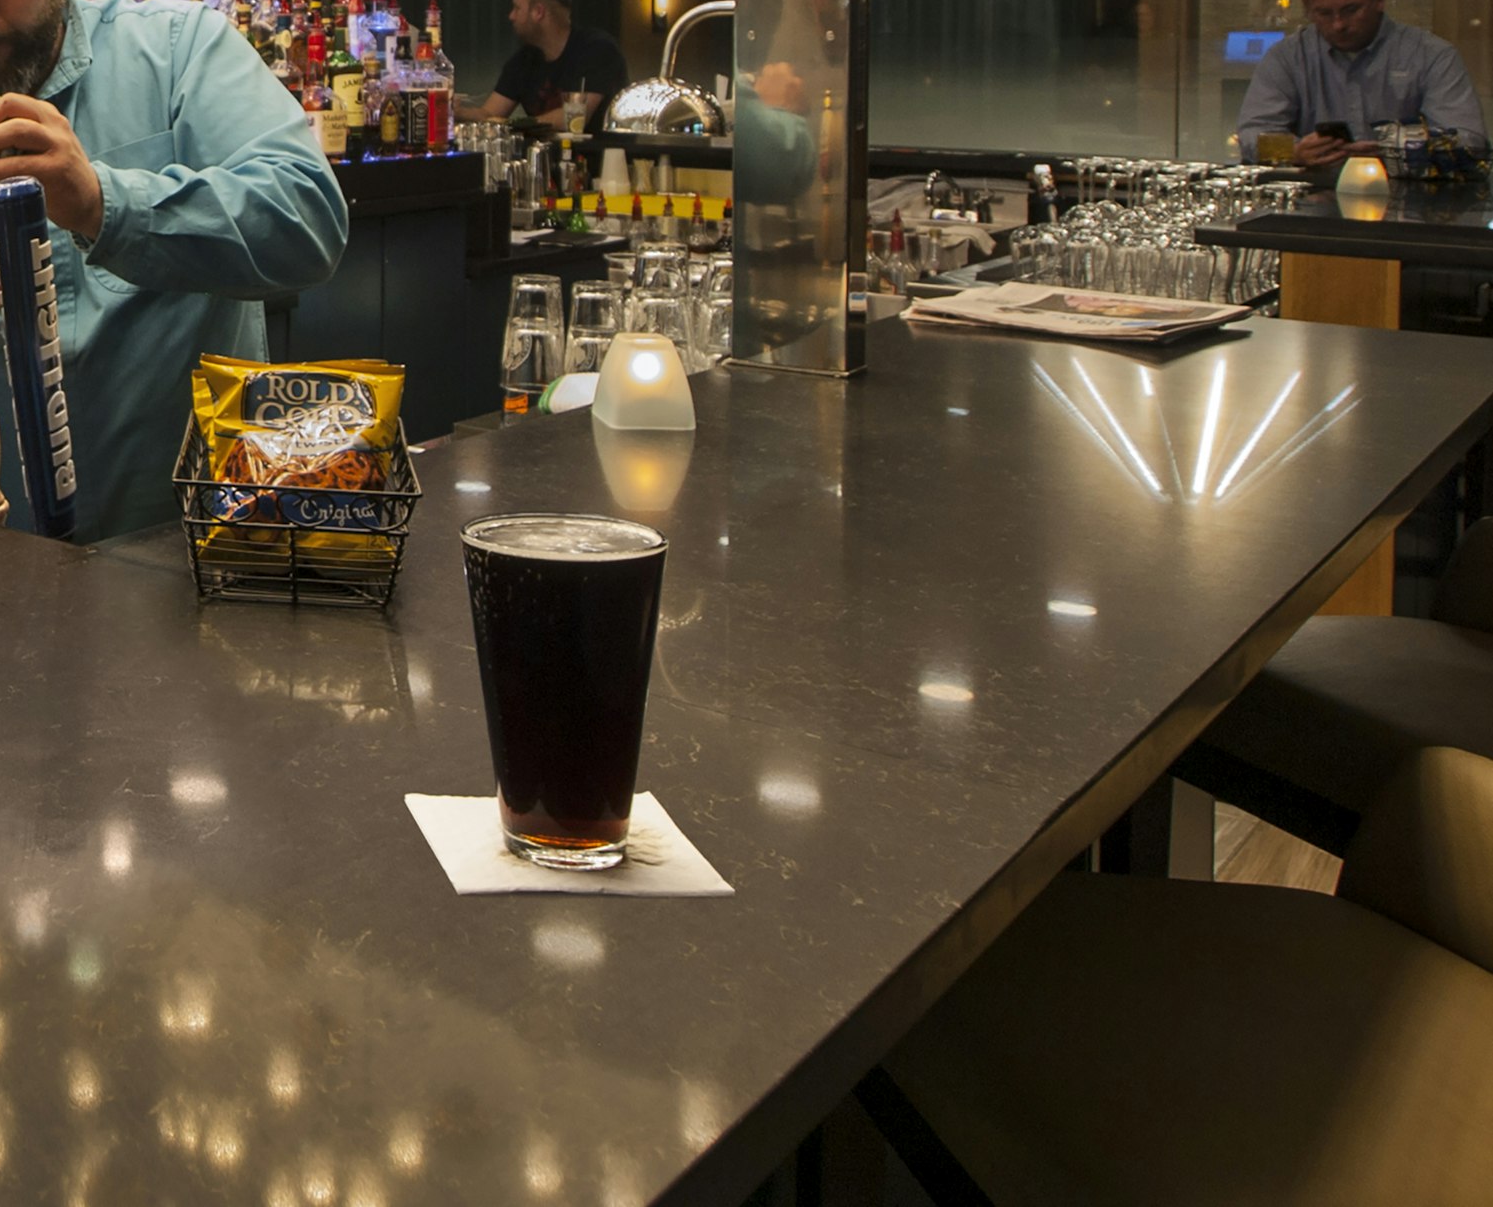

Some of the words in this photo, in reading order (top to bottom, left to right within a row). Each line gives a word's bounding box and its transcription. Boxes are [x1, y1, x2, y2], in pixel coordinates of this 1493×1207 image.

[30, 237, 64, 389] LIGHT
[47, 390, 77, 501] BUD
[266, 375, 355, 405] ROLD
